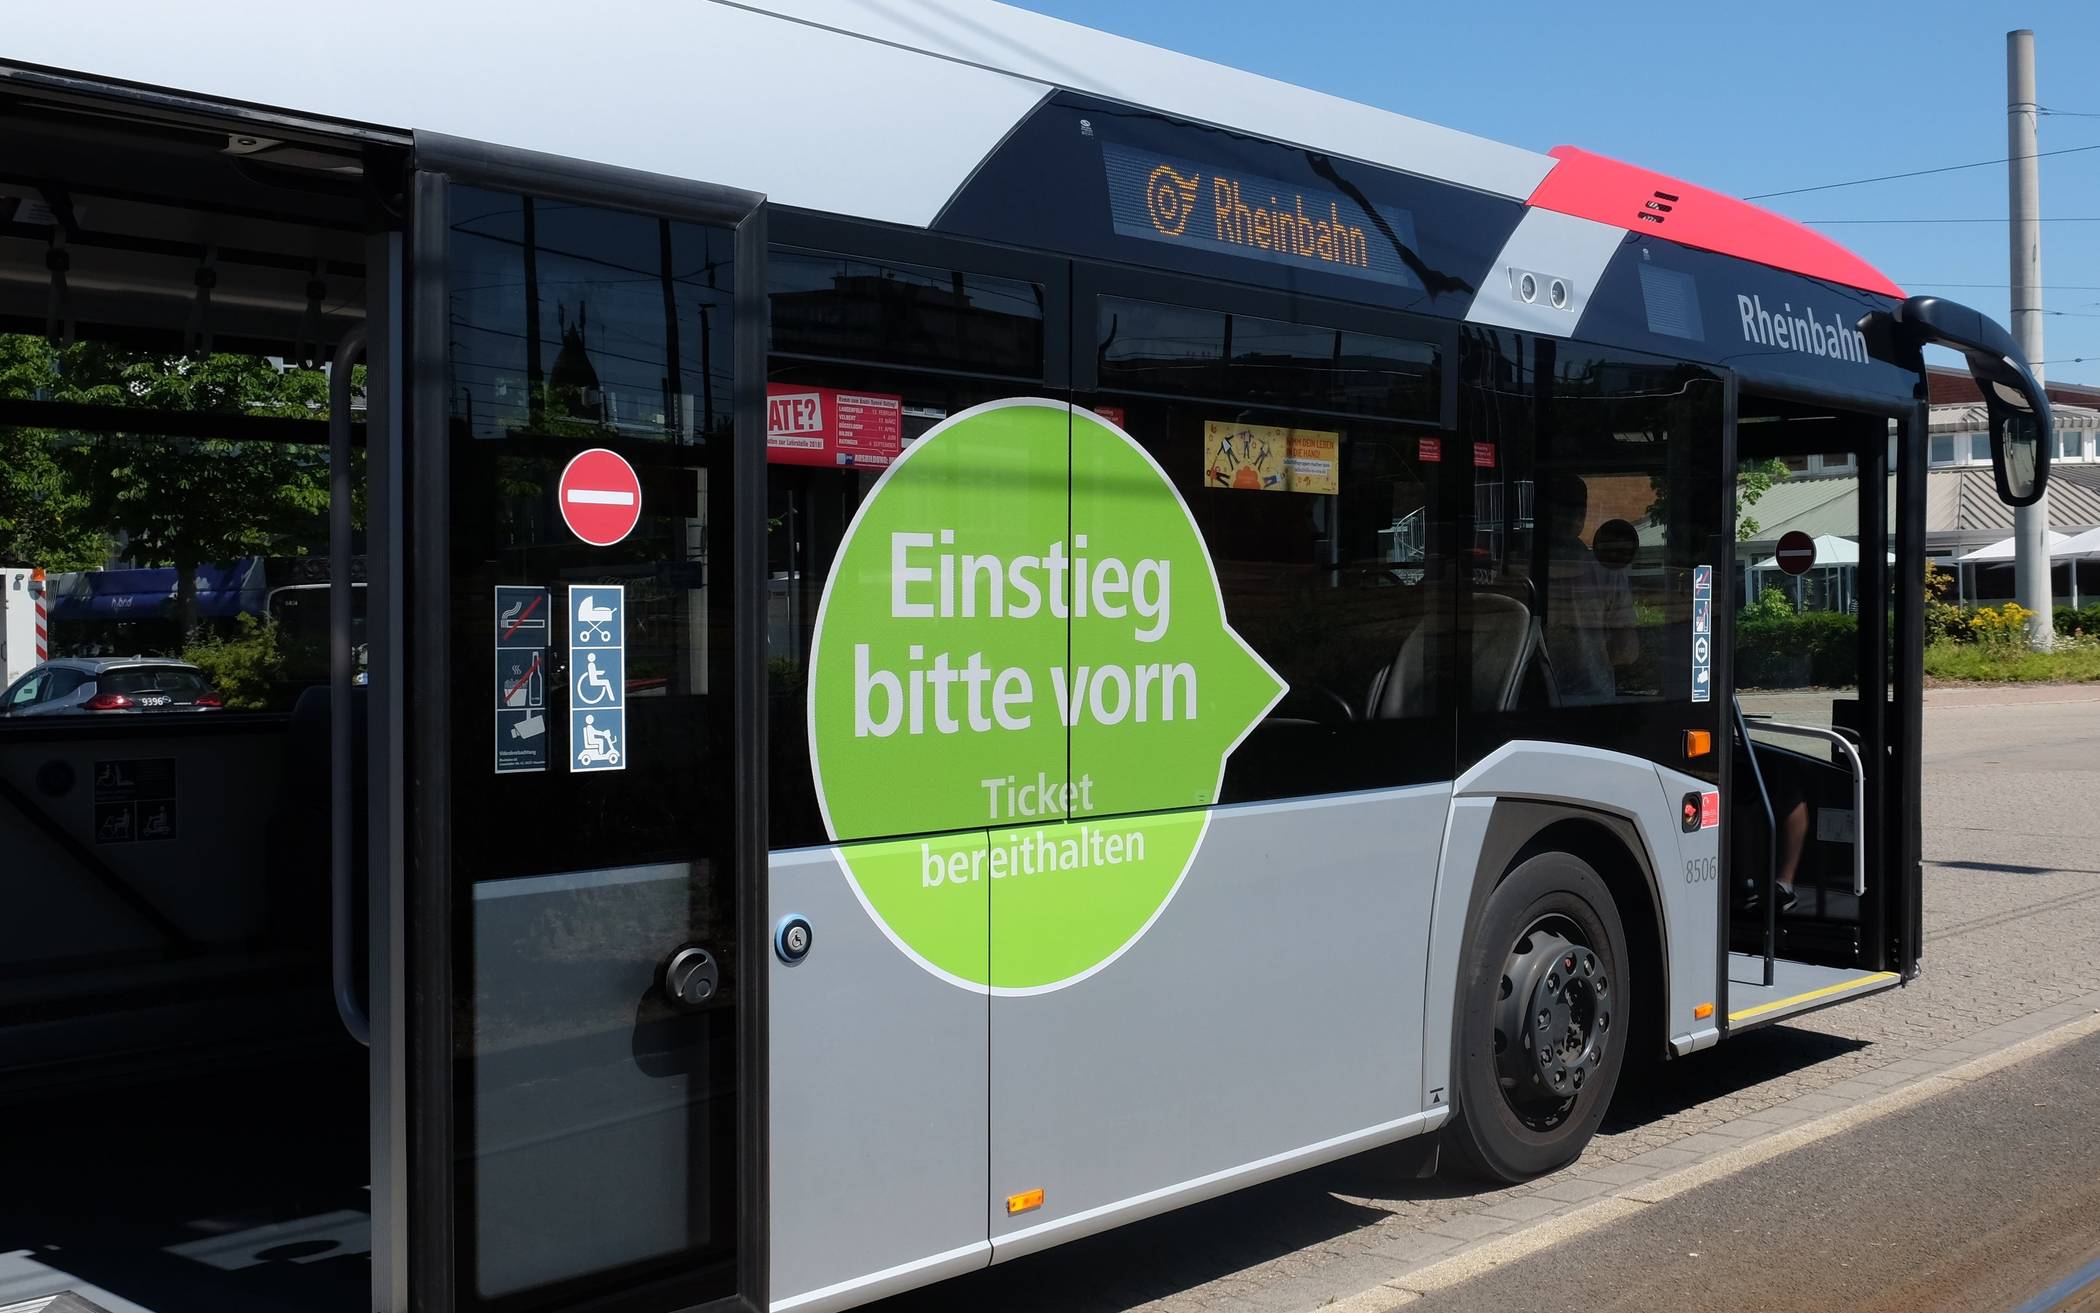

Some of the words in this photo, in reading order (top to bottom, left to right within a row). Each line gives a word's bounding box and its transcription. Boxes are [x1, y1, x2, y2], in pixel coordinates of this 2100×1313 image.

[1213, 175, 1369, 269] Rheinbahn
[1737, 293, 1870, 365] Rheinbahn
[768, 398, 817, 431] ATE?
[891, 529, 1171, 642] Einstieg
[141, 697, 164, 706] 9396
[854, 643, 1033, 738] bitte
[1050, 660, 1198, 728] vorn
[981, 771, 1094, 820] Ticket
[921, 826, 1145, 888] bereithalten
[1685, 856, 1717, 884] 8506
